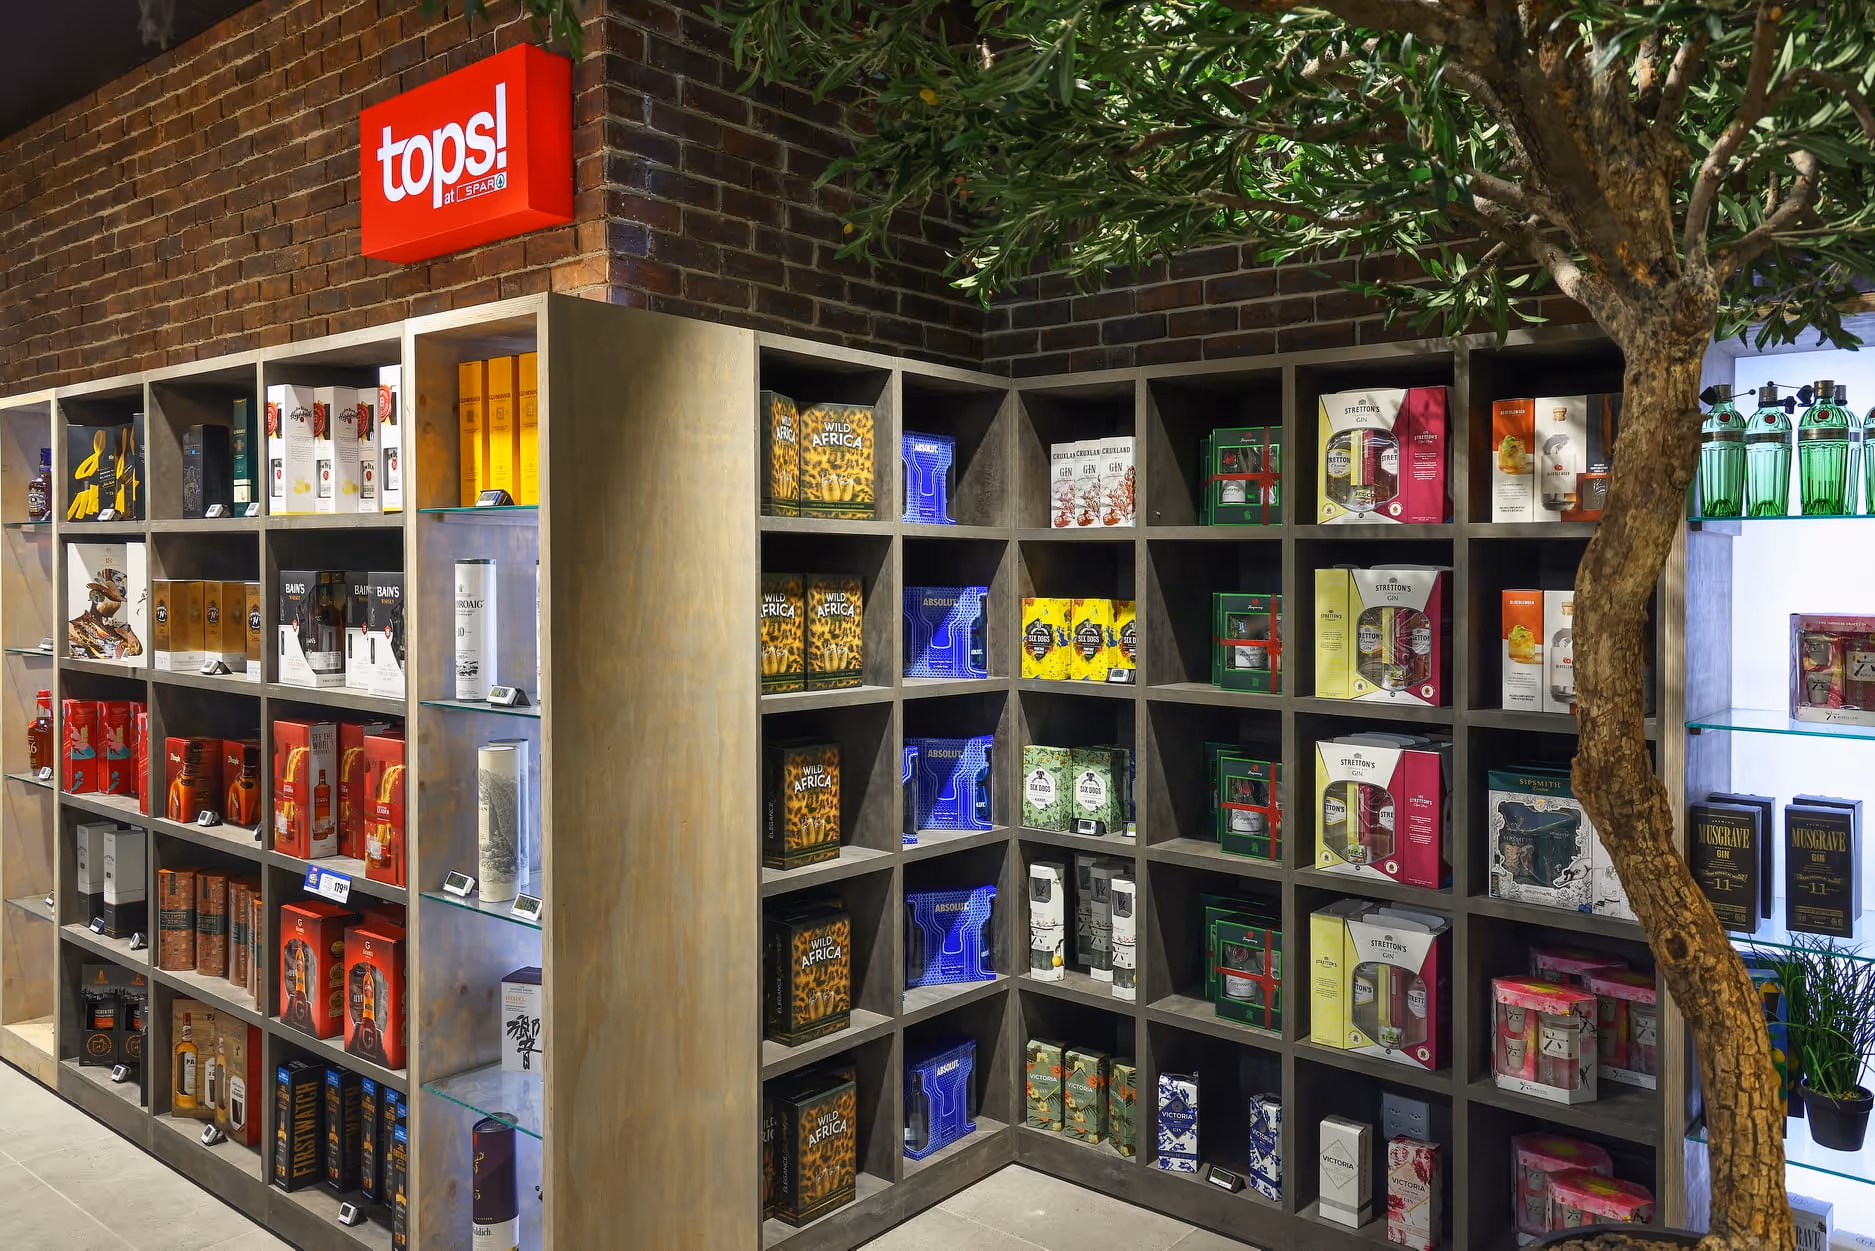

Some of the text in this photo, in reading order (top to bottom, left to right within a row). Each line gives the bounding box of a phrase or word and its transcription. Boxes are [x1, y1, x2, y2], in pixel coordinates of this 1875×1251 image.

[377, 82, 507, 209] tops!
[444, 178, 494, 205] at SPAR
[1344, 405, 1380, 415] STRETTON'S
[781, 415, 791, 427] WILD
[823, 422, 851, 433] WILD
[776, 426, 796, 444] AFRICA
[812, 432, 863, 450] AFRICA
[1052, 452, 1076, 460] CRUXLAN
[1076, 449, 1100, 457] CRUXLAN
[1101, 446, 1131, 455] CRUXLAND
[1328, 455, 1350, 463] RETTON
[1381, 454, 1398, 462] STRET
[1059, 466, 1073, 477] GIN
[1082, 463, 1097, 474] GIN
[1109, 461, 1123, 472] GIN
[285, 583, 305, 595] BAIN'S
[354, 585, 369, 596] BAIN
[377, 586, 400, 598] BAIN'S
[1375, 584, 1411, 593] STRETTON'S
[764, 592, 786, 603] WILD
[825, 592, 846, 603] WILD
[456, 600, 484, 609] ROAIG
[817, 602, 855, 619] AFRICA
[1028, 635, 1050, 643] SIX DOGS
[1077, 635, 1100, 643] SIX DOGS
[1340, 758, 1376, 769] STRETTON'S
[802, 764, 824, 776] WILD
[794, 774, 832, 794] AFRICA
[1029, 783, 1051, 793] SIX DOGS
[1519, 778, 1561, 789] SIPSMITH
[1089, 786, 1102, 795] DOGS
[1325, 803, 1345, 813] TTON'S
[1698, 823, 1750, 849] MUSGRAVE
[1791, 827, 1846, 852] MUSGRAVE
[1716, 850, 1730, 860] GIN
[1811, 853, 1826, 863] GIN
[333, 881, 344, 894] 179
[1713, 878, 1731, 891] 11
[1808, 882, 1827, 895] 11
[297, 918, 303, 927] G
[365, 941, 371, 950] G
[810, 935, 833, 950] WILD
[1370, 939, 1407, 953] STRETTON'S
[801, 945, 842, 970] AFRICA
[1382, 952, 1395, 960] GIN
[1355, 984, 1373, 994] TON'S
[1029, 1073, 1058, 1083] VICTORIA
[1067, 1082, 1093, 1093] VICTORIA
[817, 1110, 839, 1127] WILD
[1161, 1111, 1193, 1120] VICTORIA
[808, 1119, 847, 1148] AFRICA
[1322, 1154, 1355, 1170] VICTORIA
[1391, 1176, 1426, 1192] VICTORIA
[1796, 1224, 1822, 1250] RAVE
